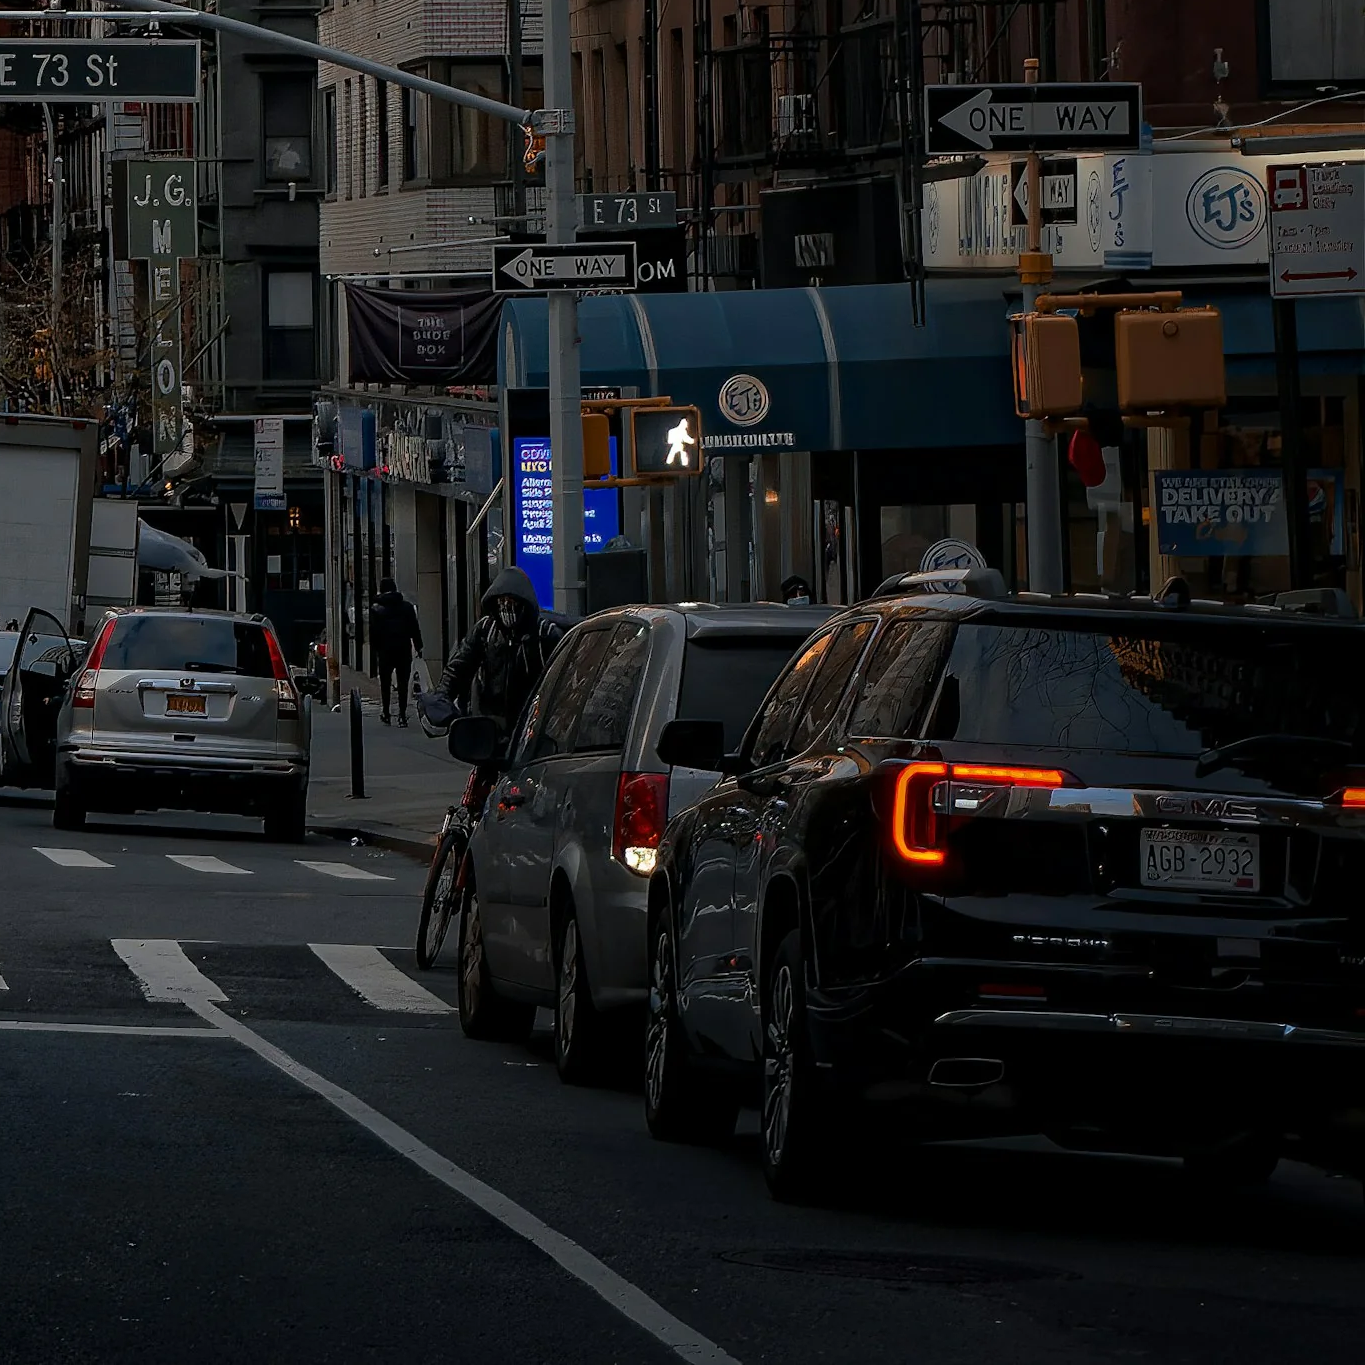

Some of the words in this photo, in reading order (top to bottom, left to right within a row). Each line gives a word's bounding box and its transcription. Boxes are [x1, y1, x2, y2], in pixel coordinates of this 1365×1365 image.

[0, 54, 17, 86] E
[32, 54, 69, 87] 73
[86, 54, 118, 87] St
[969, 107, 1025, 132] ONE
[1056, 106, 1117, 131] WAY
[133, 174, 192, 206] J.G.
[1050, 178, 1070, 203] WAY
[593, 199, 605, 224] E
[614, 198, 638, 223] 73
[648, 198, 661, 213] St
[1202, 182, 1255, 232] EJ's
[516, 259, 555, 277] ONE
[575, 257, 616, 275] WAY
[1162, 488, 1266, 505] DELIVERY
[1161, 505, 1222, 524] TAKE
[1226, 505, 1276, 524] OUT
[1155, 795, 1257, 819] GMC
[1147, 844, 1254, 876] AGB-2932
